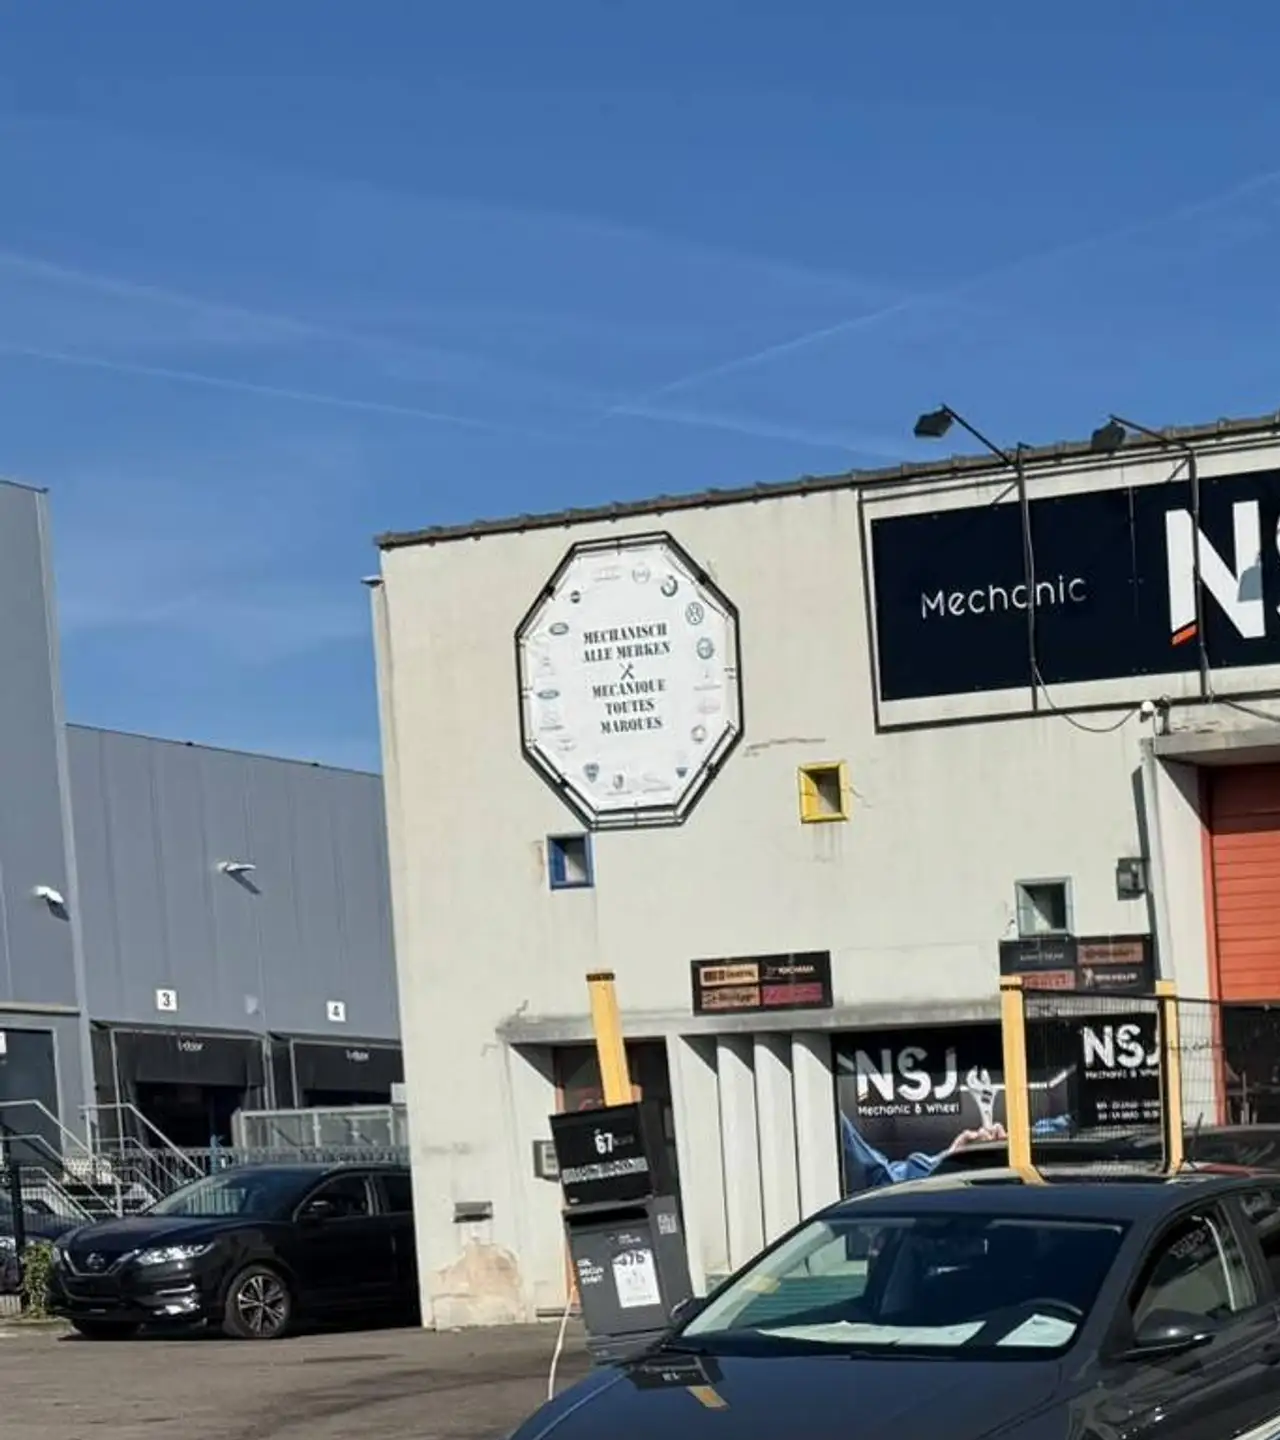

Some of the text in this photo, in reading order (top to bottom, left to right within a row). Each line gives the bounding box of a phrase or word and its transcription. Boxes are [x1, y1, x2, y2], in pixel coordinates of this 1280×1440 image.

[583, 622, 668, 645] MECHANISCH
[583, 641, 671, 662] ALLE MERKEN
[592, 679, 667, 698] MECANIQUE
[605, 699, 656, 716] TOUTES
[600, 717, 663, 735] MARQUES
[162, 992, 171, 1007] 3
[855, 1046, 958, 1102] NSJ
